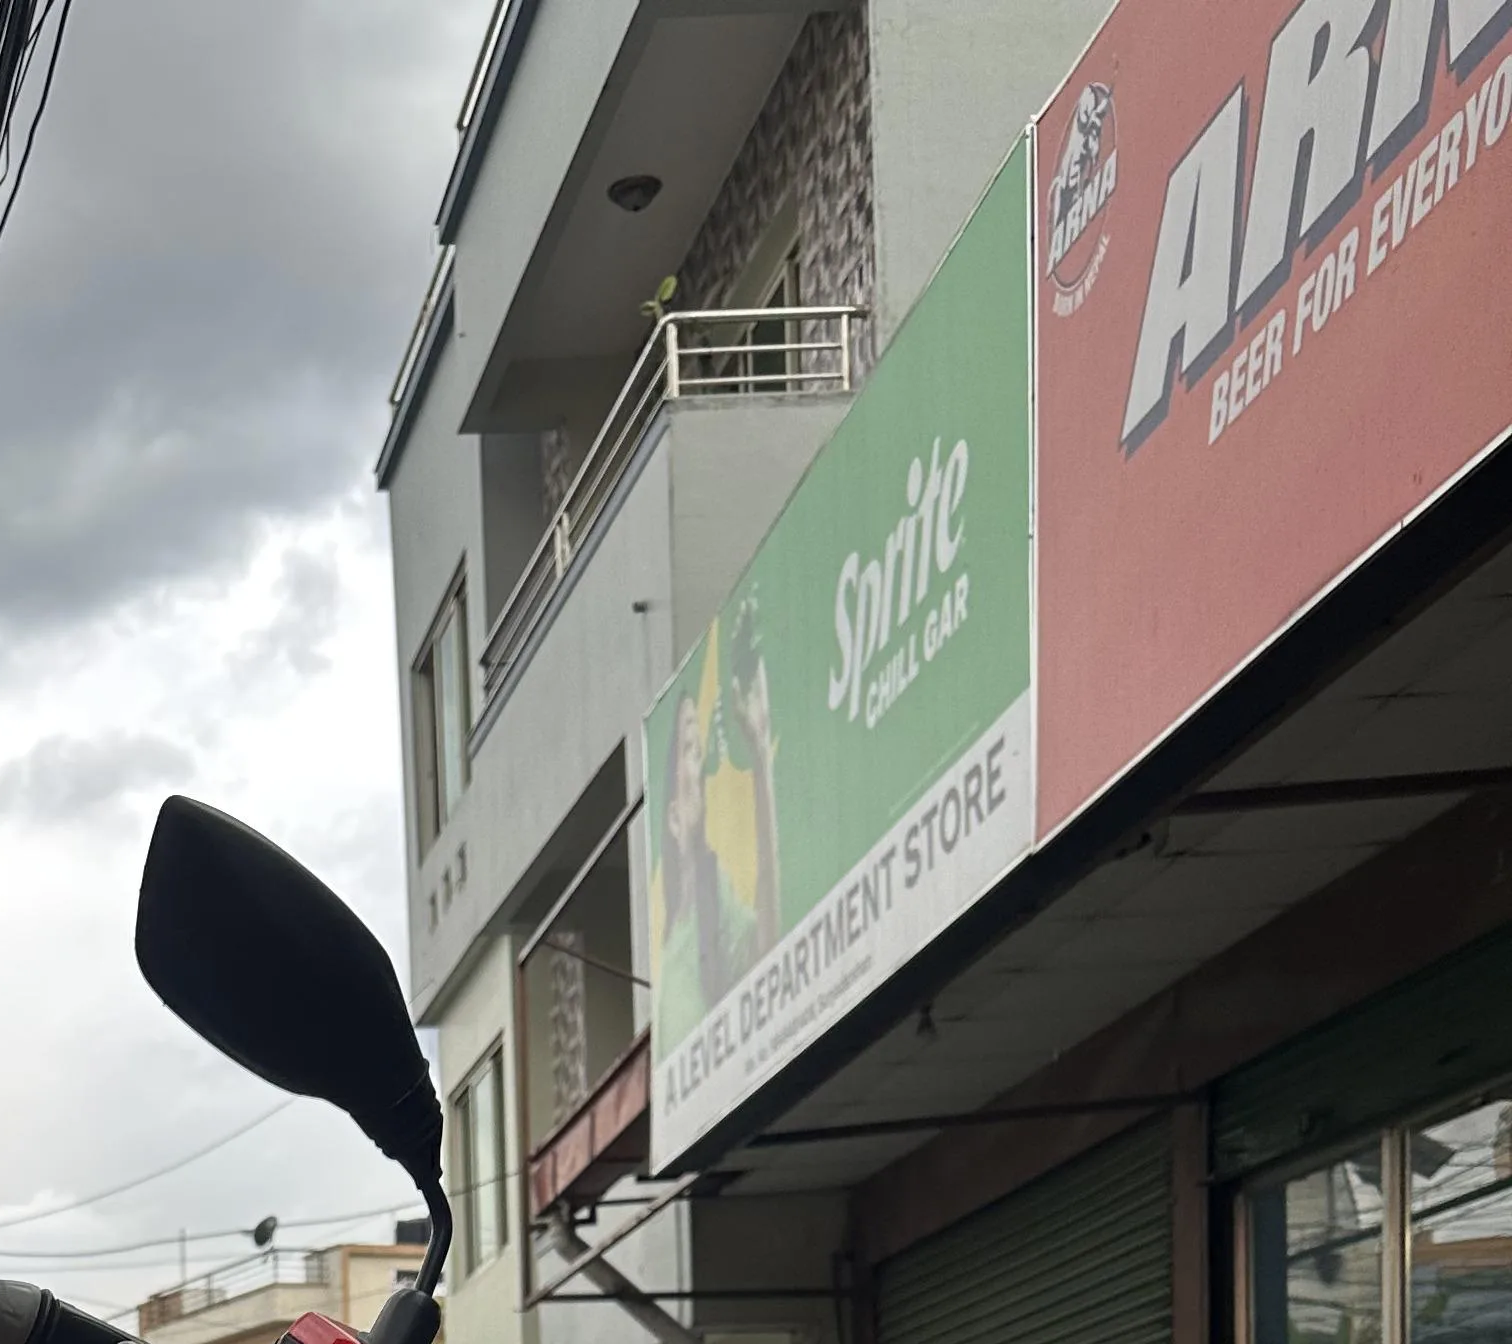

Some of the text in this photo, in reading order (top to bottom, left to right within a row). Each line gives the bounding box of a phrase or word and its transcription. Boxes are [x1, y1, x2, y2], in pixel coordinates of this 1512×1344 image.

[1045, 147, 1119, 280] ARNA
[1207, 307, 1287, 447] BEER
[1291, 225, 1360, 357] FOR
[827, 436, 970, 724] Sprite
[865, 571, 971, 730] CHILL GAR
[663, 1064, 679, 1118] A
[679, 1011, 736, 1100] LEVEL
[738, 848, 898, 1044] DEPARTMENT
[904, 736, 1009, 890] STORE
